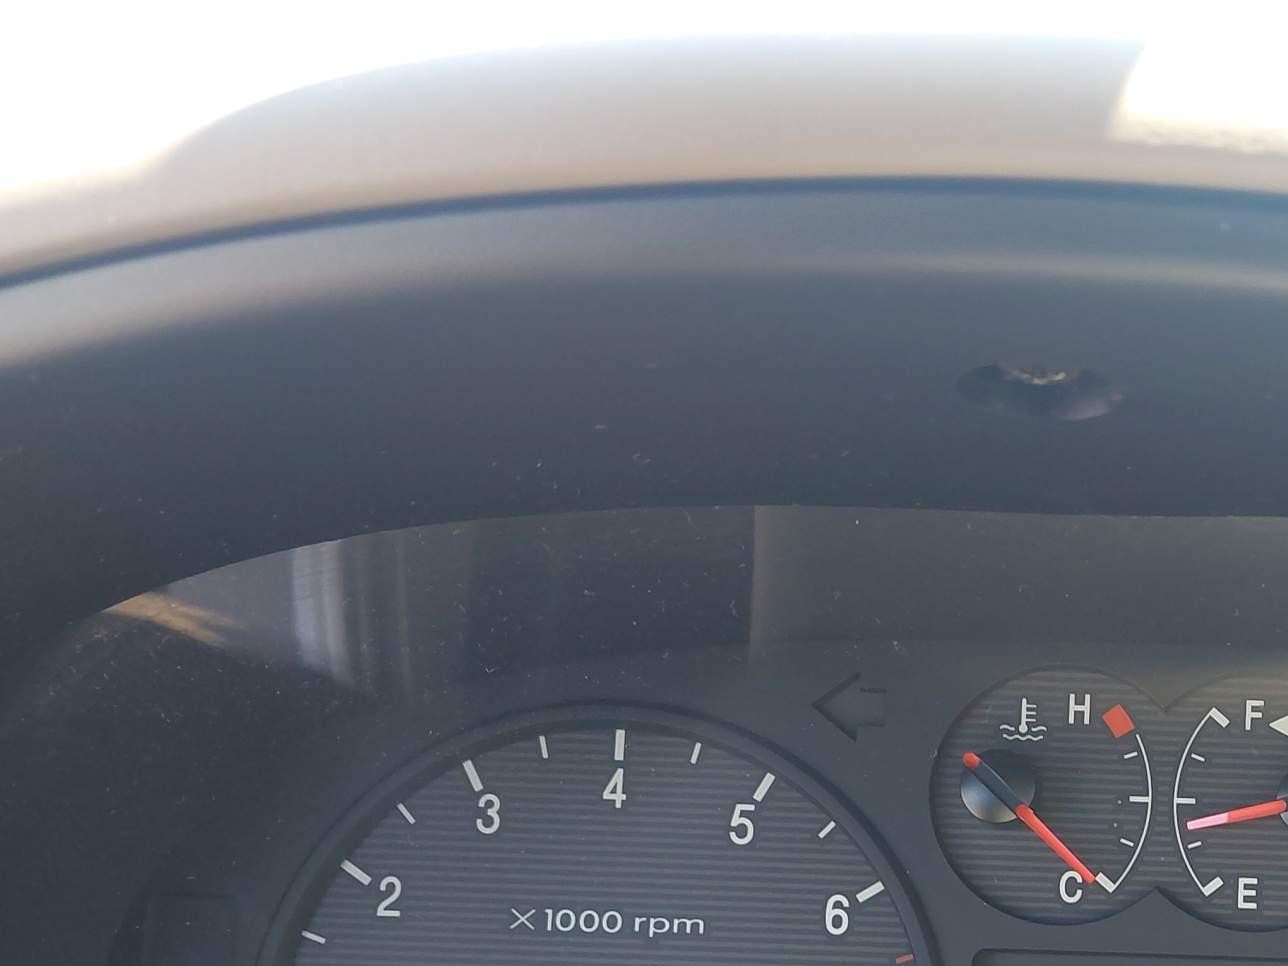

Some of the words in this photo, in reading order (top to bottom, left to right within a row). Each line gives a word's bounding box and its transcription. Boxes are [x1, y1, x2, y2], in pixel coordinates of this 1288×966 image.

[1069, 693, 1091, 725] H
[1244, 700, 1265, 731] F
[602, 768, 626, 809] 4
[476, 793, 501, 835] 3
[729, 805, 755, 845] 5
[376, 877, 402, 917] 2
[1059, 872, 1083, 904] C
[1237, 878, 1258, 910] E
[633, 913, 705, 938] rpm
[824, 894, 849, 935] 6
